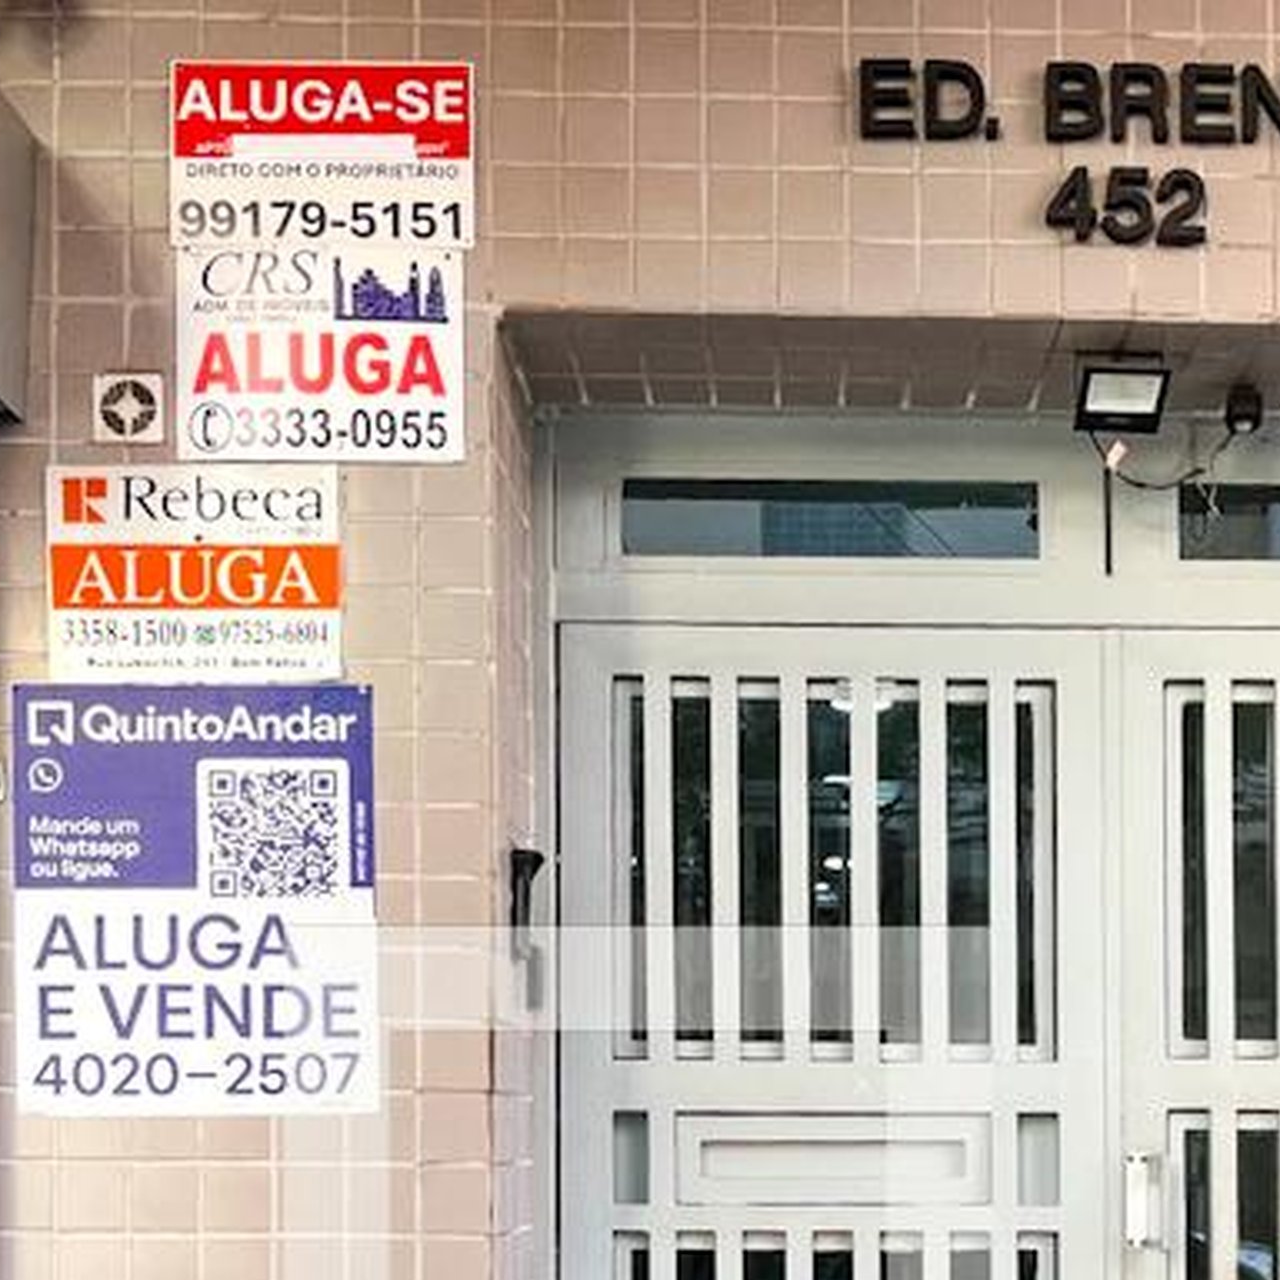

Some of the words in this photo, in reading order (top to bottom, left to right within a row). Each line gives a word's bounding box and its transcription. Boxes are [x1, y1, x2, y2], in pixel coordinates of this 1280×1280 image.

[177, 78, 465, 122] ALUGA-SE
[858, 58, 1001, 143] ED.
[186, 162, 254, 178] DIRETO
[258, 162, 302, 178] COM
[306, 162, 321, 178] O
[178, 199, 462, 240] 99179-5151
[1045, 165, 1208, 248] 452
[201, 249, 320, 298] CRS
[192, 331, 447, 398] ALUGA
[235, 405, 448, 449] 3333-0955
[121, 474, 323, 523] Rebeca
[70, 549, 321, 606] ALUGA
[62, 617, 188, 647] 3358-1500
[81, 703, 358, 744] QuintoAndar
[28, 815, 103, 835] Mande
[105, 819, 140, 835] um
[28, 837, 141, 860] Whatsapp
[29, 862, 58, 878] ou
[61, 859, 119, 882] ligue.
[33, 913, 300, 972] ALUGA
[38, 983, 77, 1040] E
[98, 983, 361, 1040] VENDE
[33, 1052, 361, 1096] 4020-2507
